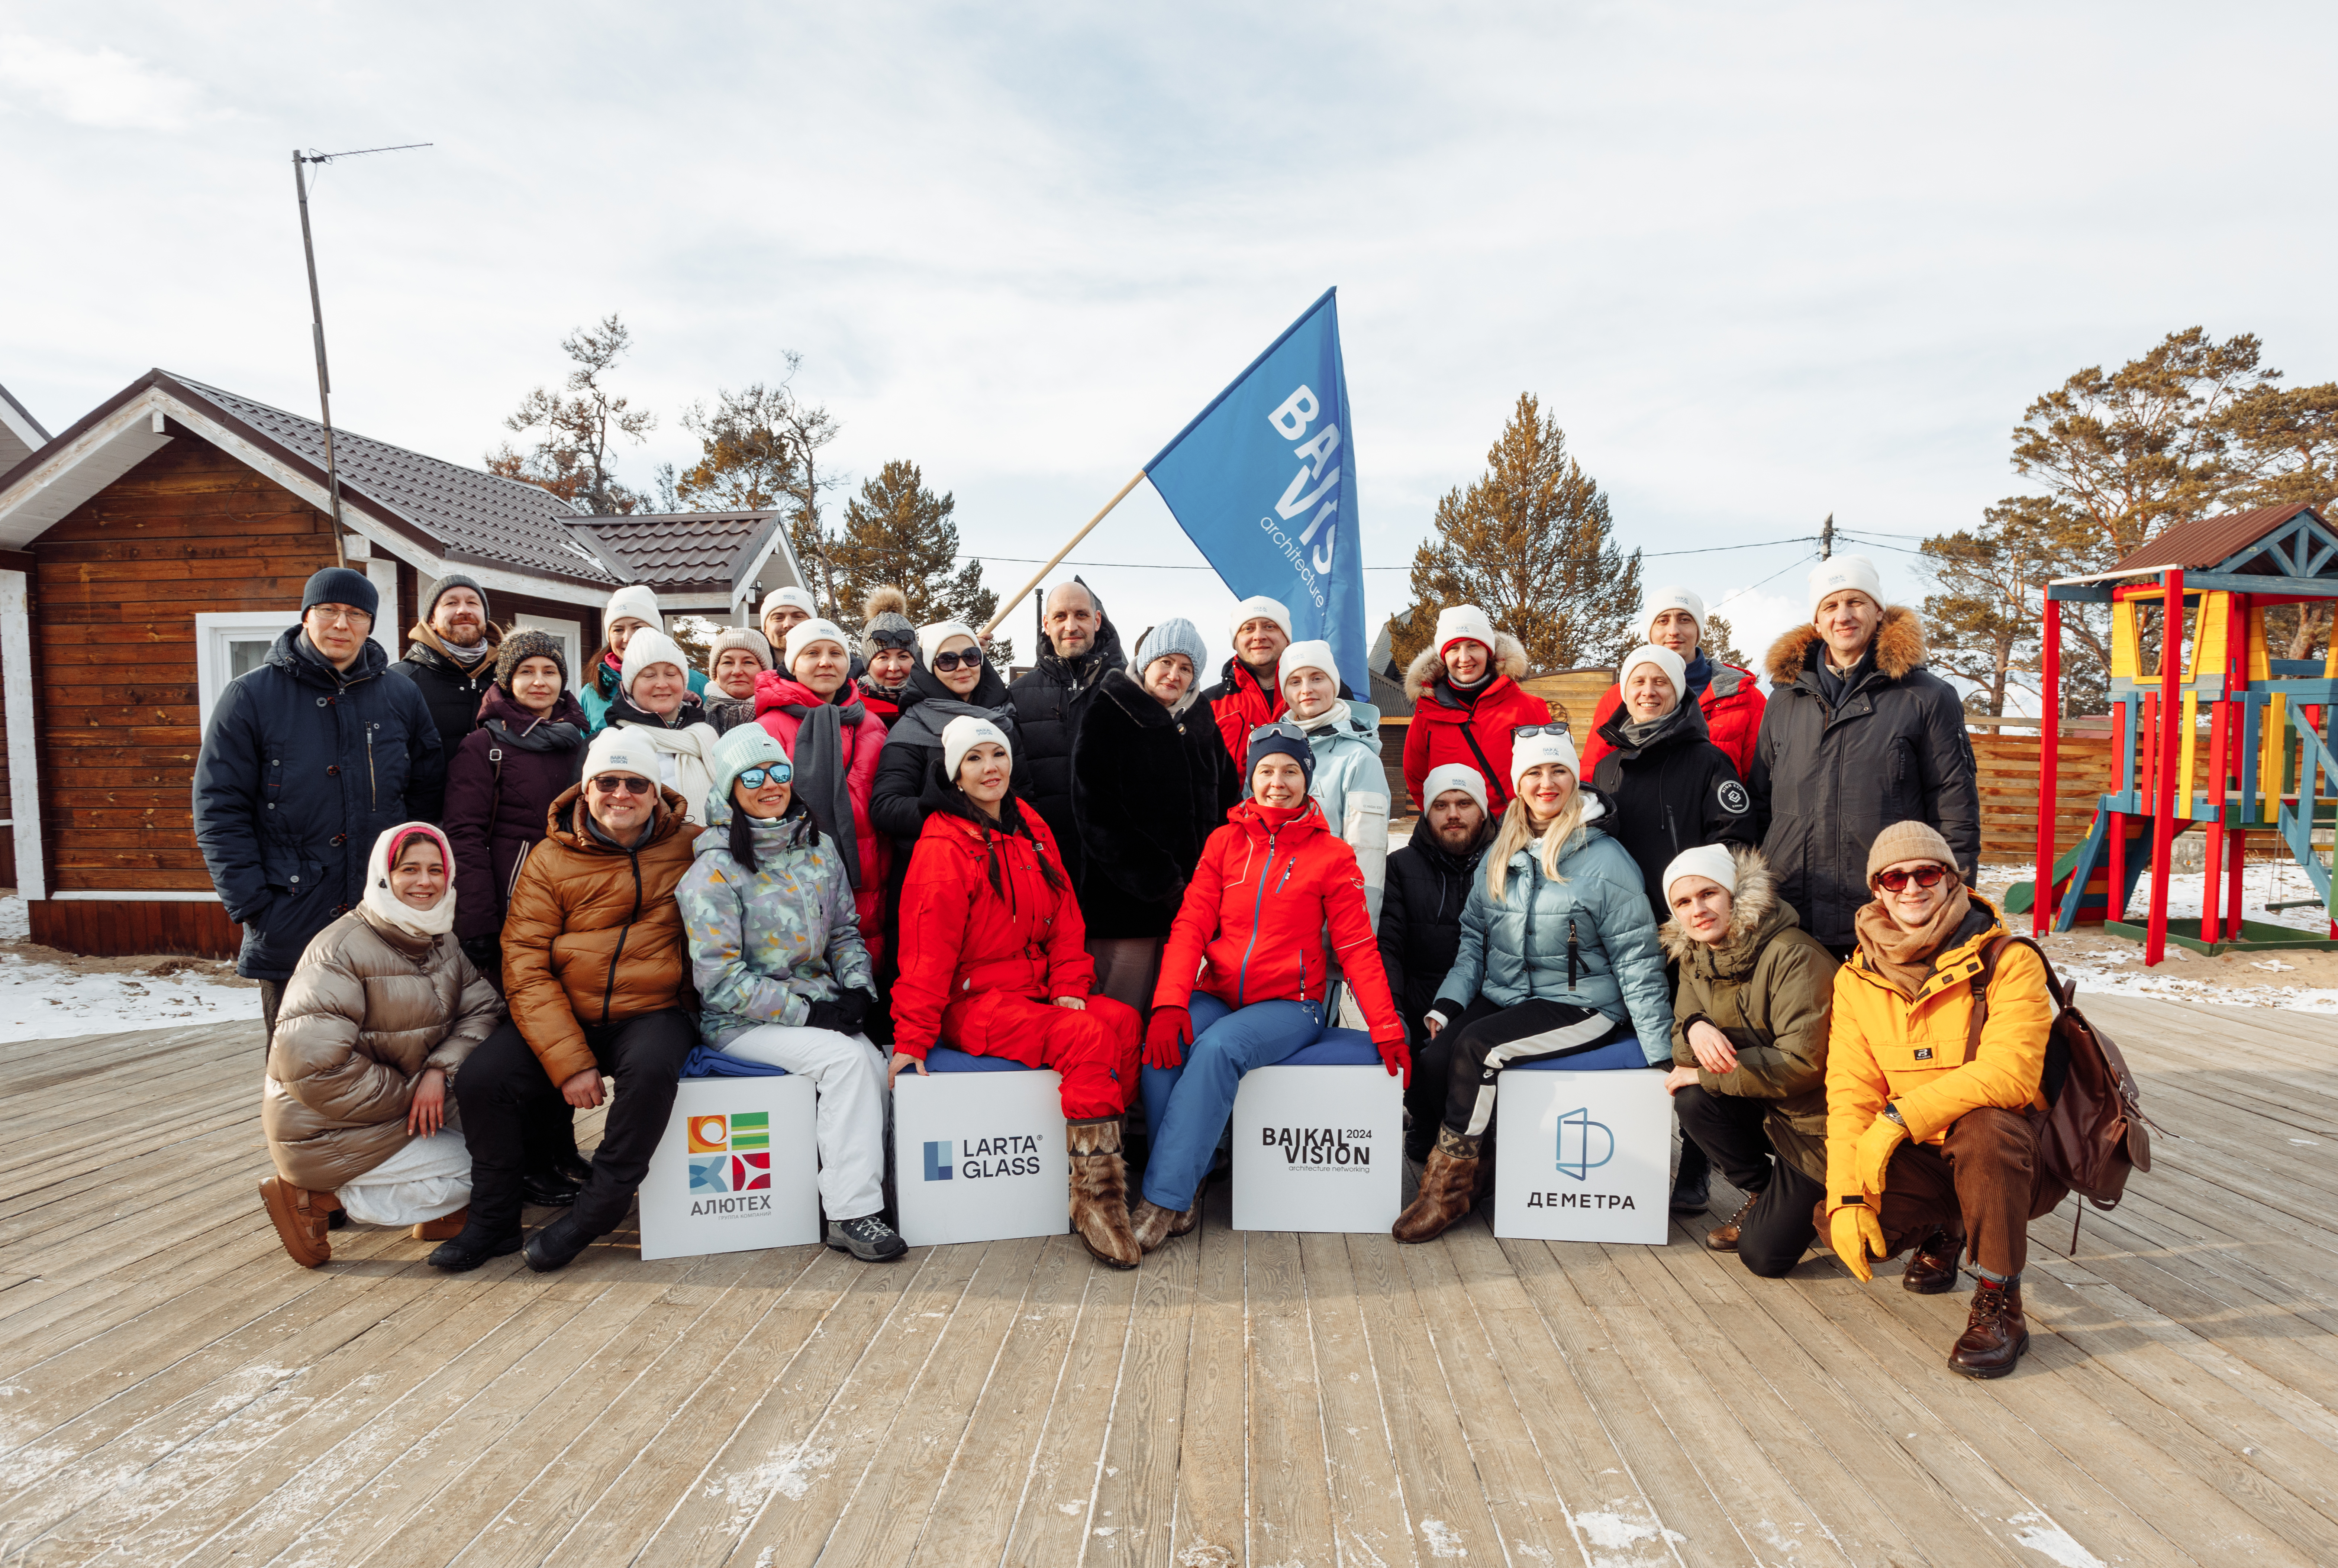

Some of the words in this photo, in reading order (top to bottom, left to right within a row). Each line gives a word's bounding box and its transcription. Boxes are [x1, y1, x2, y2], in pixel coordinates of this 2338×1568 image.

[1260, 517, 1324, 608] architecture
[1721, 783, 1732, 793] HIGH
[1263, 1128, 1349, 1147] BAIKAL
[1347, 1129, 1372, 1138] 2024
[1285, 1146, 1370, 1165] VISION
[963, 1157, 1040, 1179] GLASS
[690, 1195, 771, 1216] АЛЮТЕХ
[1527, 1192, 1635, 1210] ДЕМЕТРА
